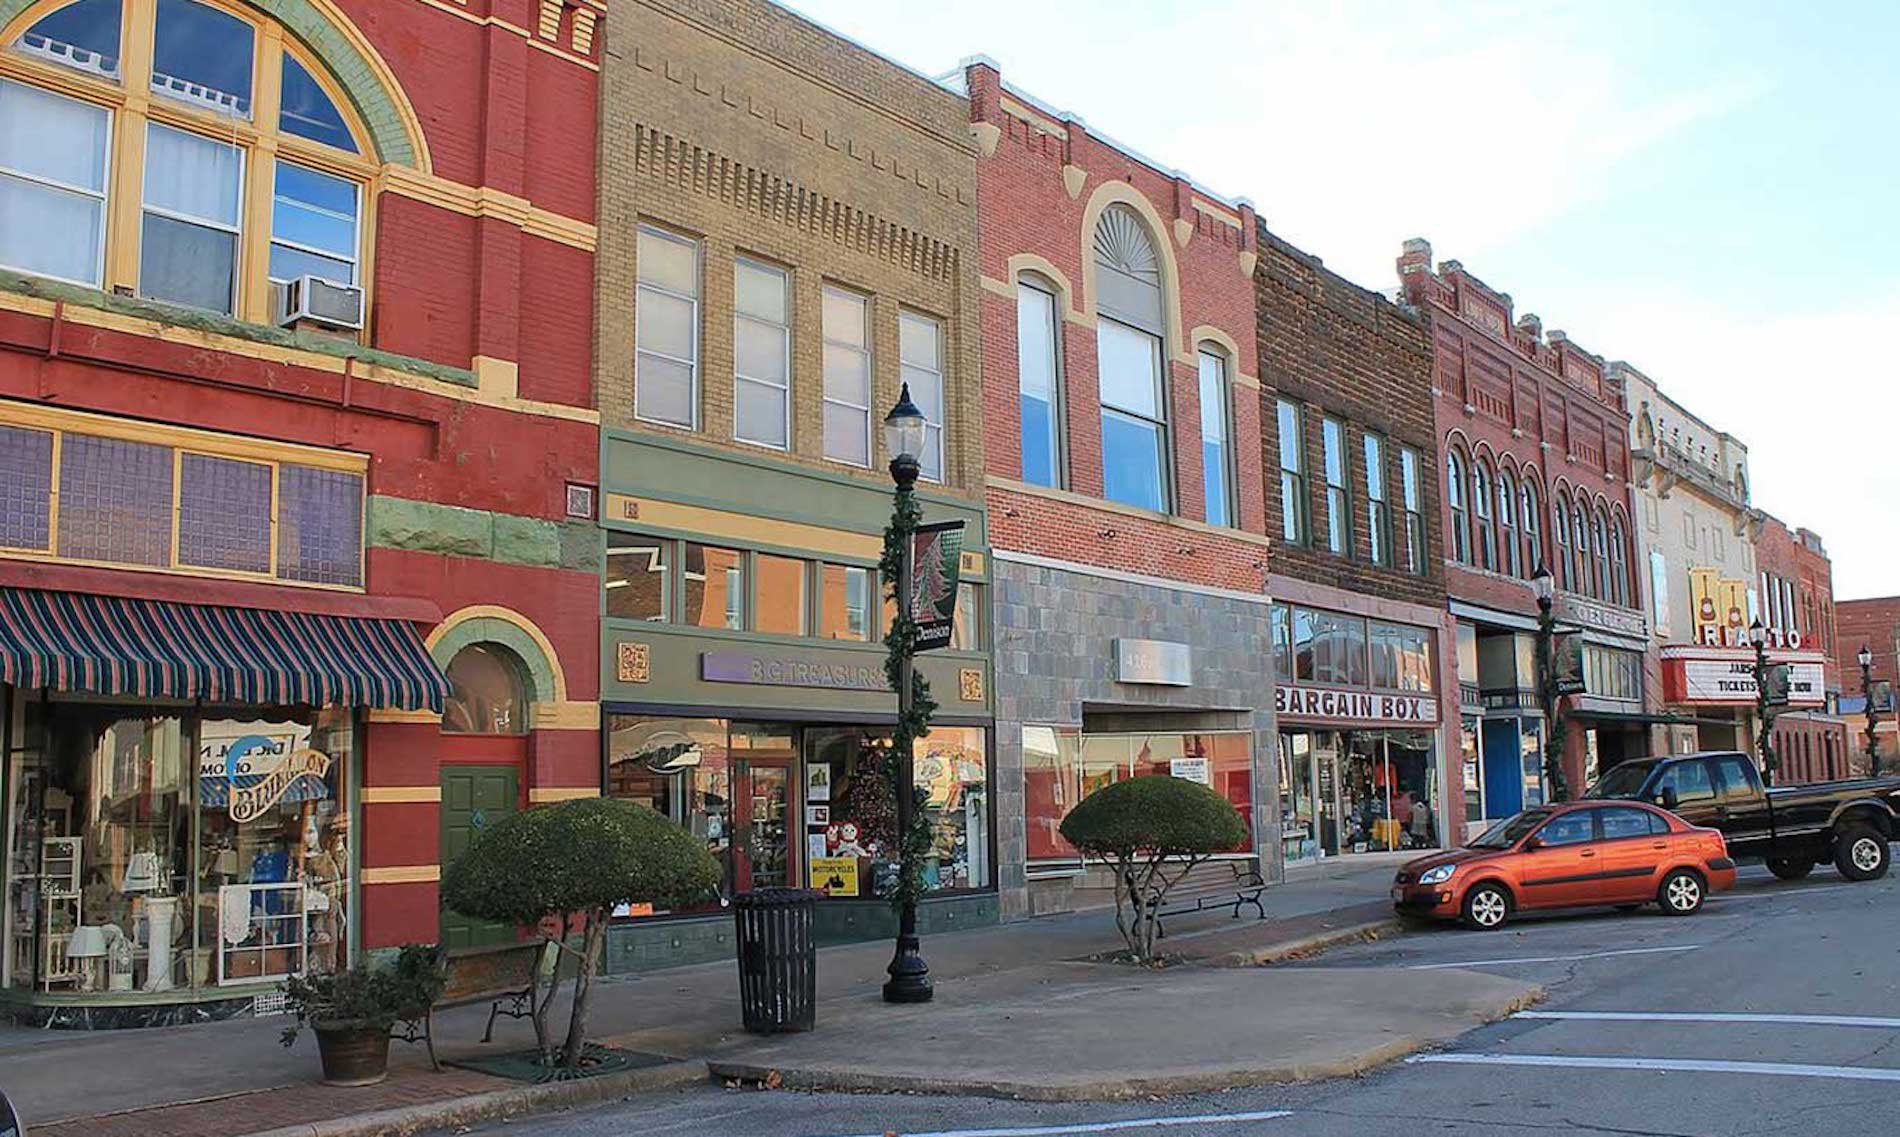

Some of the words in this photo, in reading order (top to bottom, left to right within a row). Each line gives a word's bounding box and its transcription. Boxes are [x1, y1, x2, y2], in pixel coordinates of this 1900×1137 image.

[916, 623, 950, 641] Denison
[1718, 681, 1756, 692] TICKETS
[1275, 688, 1372, 717] BARGAIN
[1382, 697, 1421, 719] BOX
